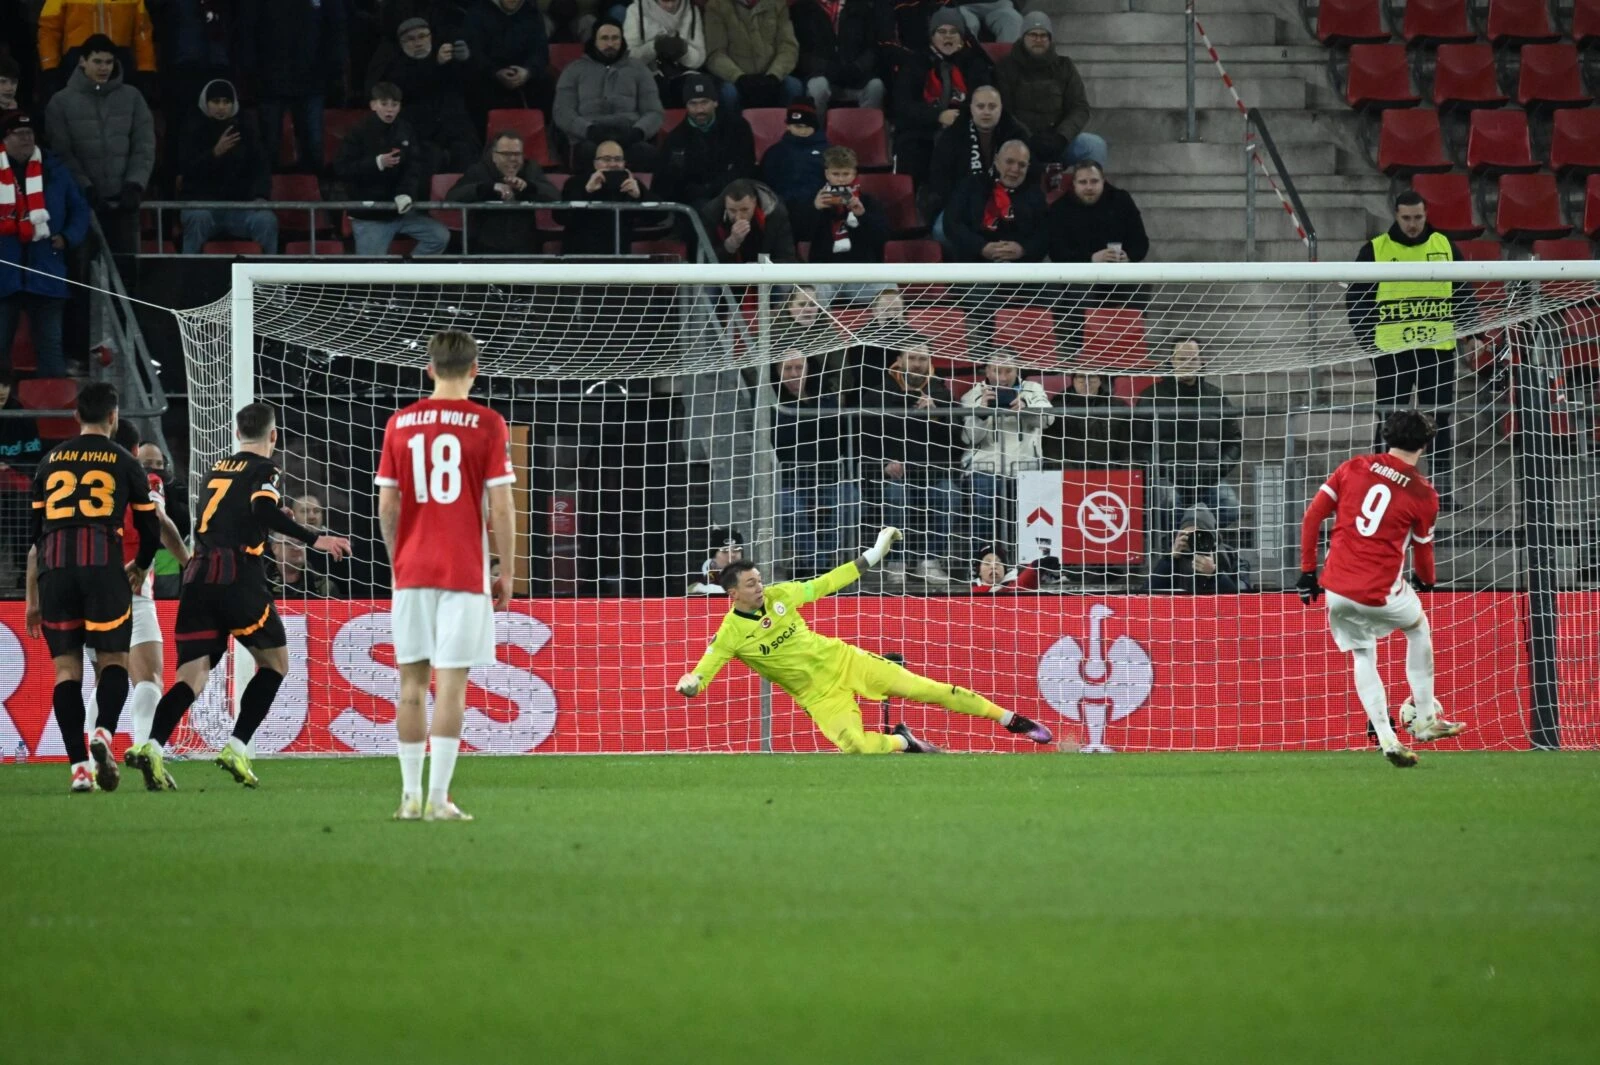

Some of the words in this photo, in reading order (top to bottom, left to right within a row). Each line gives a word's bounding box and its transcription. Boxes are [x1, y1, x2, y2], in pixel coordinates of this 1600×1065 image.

[440, 409, 480, 428] WOLFE
[49, 451, 79, 463] KAAN
[80, 451, 118, 464] AYHAN
[211, 459, 248, 472] SALLAI
[407, 432, 462, 505] 18
[1369, 461, 1412, 488] PARROTT
[45, 469, 117, 520] 23
[197, 478, 234, 534] 7
[1355, 483, 1392, 537] 9
